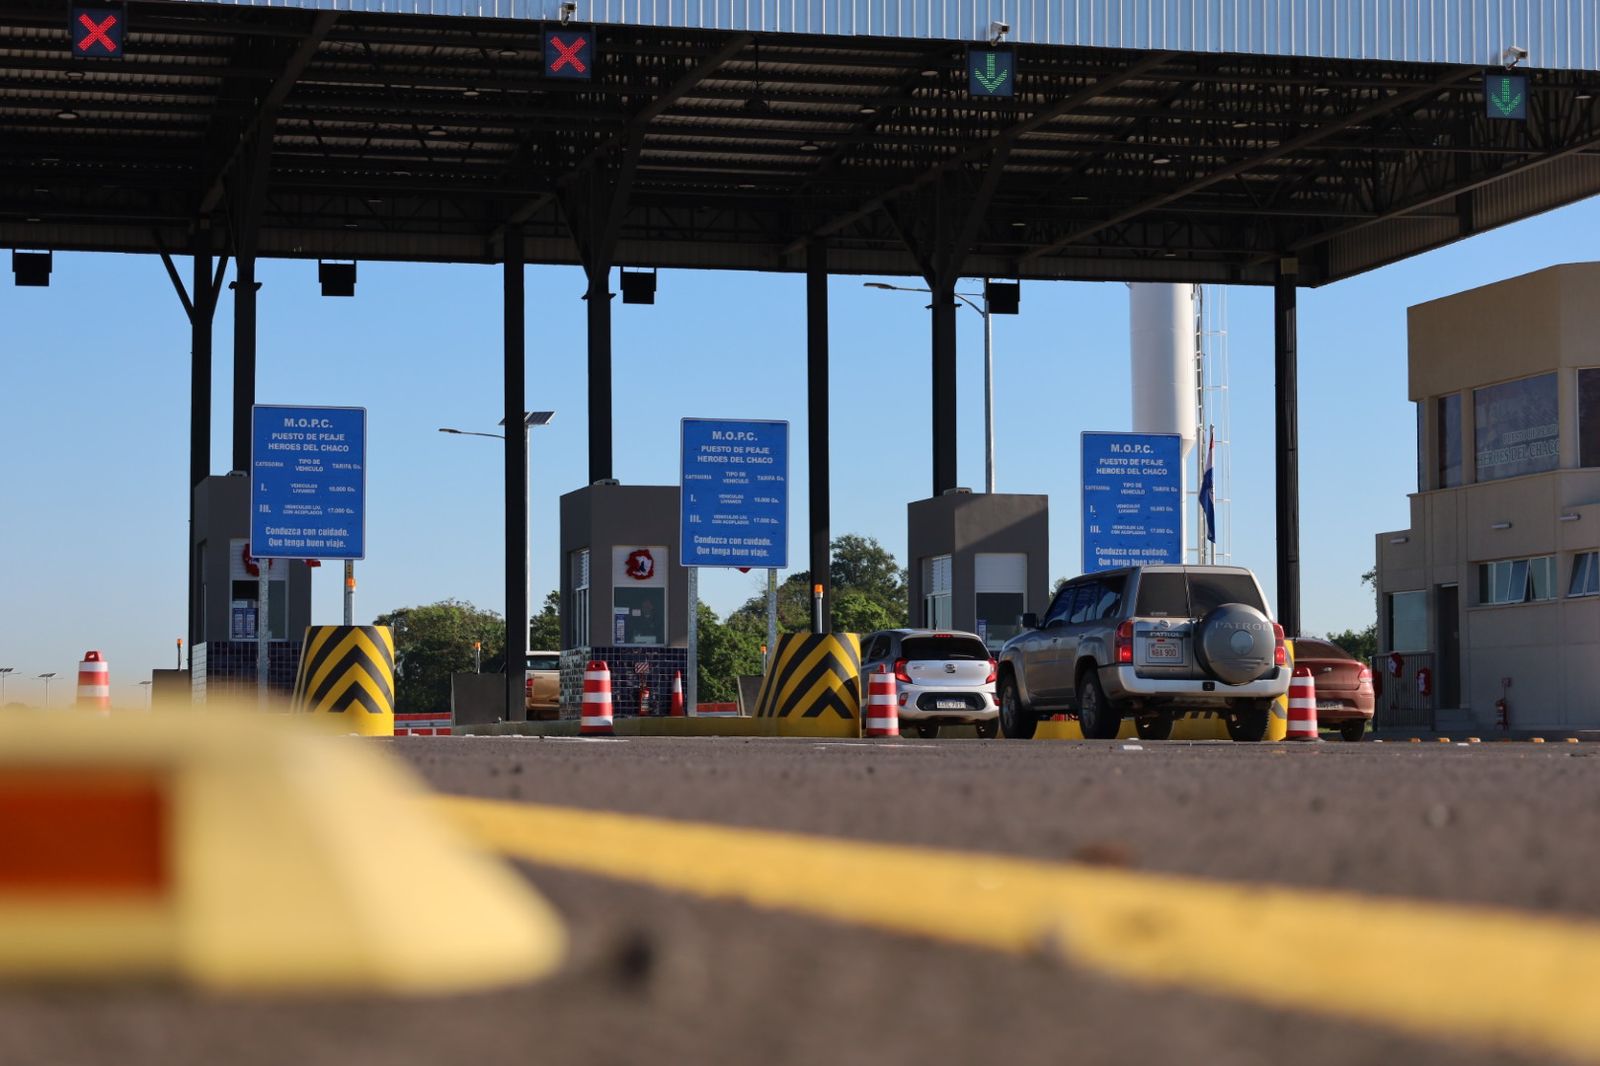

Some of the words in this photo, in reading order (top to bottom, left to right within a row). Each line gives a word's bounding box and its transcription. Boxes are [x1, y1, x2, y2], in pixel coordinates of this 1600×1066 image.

[284, 418, 333, 428] M.O.P.C.
[272, 432, 304, 440] PUESTO
[712, 431, 758, 441] M.O.P.C.
[268, 443, 301, 451] HEROES
[1110, 444, 1154, 454] M.O.P.C.
[266, 527, 300, 535] Conduzca
[318, 528, 350, 536] cuidado.
[268, 538, 282, 548] Que
[284, 538, 304, 548] tenga
[326, 540, 346, 548] viaje.
[694, 536, 728, 544] Conduzca
[744, 538, 772, 546] cuidado.
[696, 546, 710, 556] Que
[712, 548, 730, 556] tenga
[732, 548, 749, 556] buen
[750, 548, 769, 557] viaje.
[1096, 547, 1126, 556] Conduzca
[1142, 548, 1168, 556] cuidado.
[1098, 558, 1110, 567] Que
